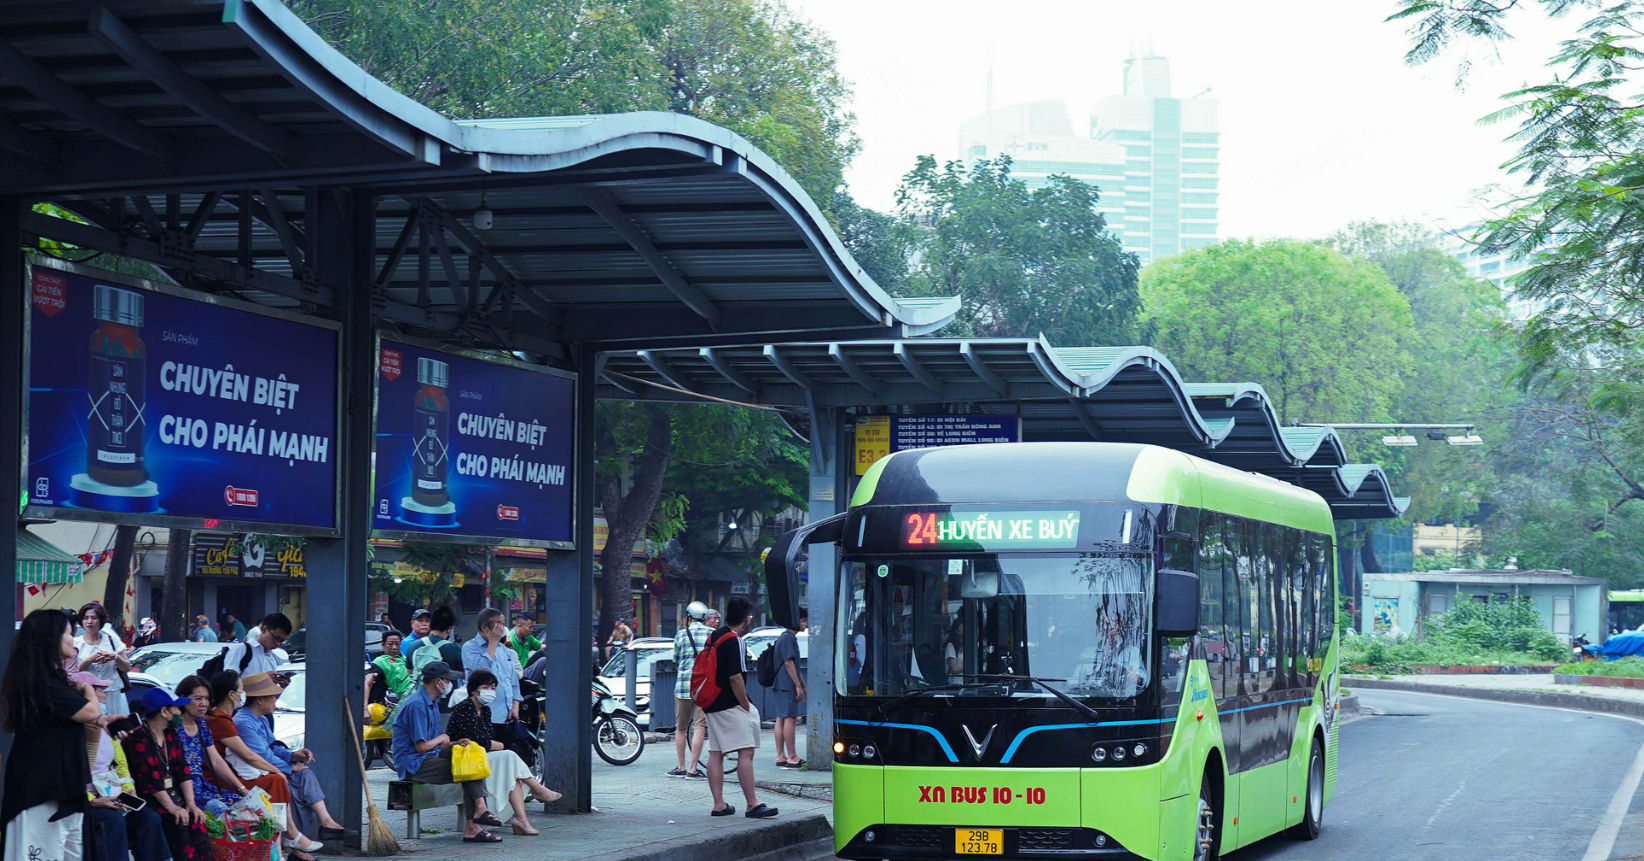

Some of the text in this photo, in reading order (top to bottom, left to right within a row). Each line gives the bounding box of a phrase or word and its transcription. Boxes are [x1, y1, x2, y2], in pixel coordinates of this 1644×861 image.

[1027, 142, 1048, 151] EVN
[160, 361, 299, 415] CHUYÊN BIỆT
[159, 414, 328, 467] CHO PHÁI MẠNH
[458, 412, 547, 451] CHUYÊN BIỆT
[456, 452, 488, 477] CHO
[490, 454, 524, 481] PHÁI
[526, 461, 565, 490] MẠNH
[908, 513, 1080, 544] 24 HUYẾN XE BUÝ
[951, 786, 987, 804] BUS
[993, 787, 1012, 804] 10
[1026, 787, 1046, 804] 10
[961, 842, 997, 853] 123.78
[968, 831, 989, 841] 29B
